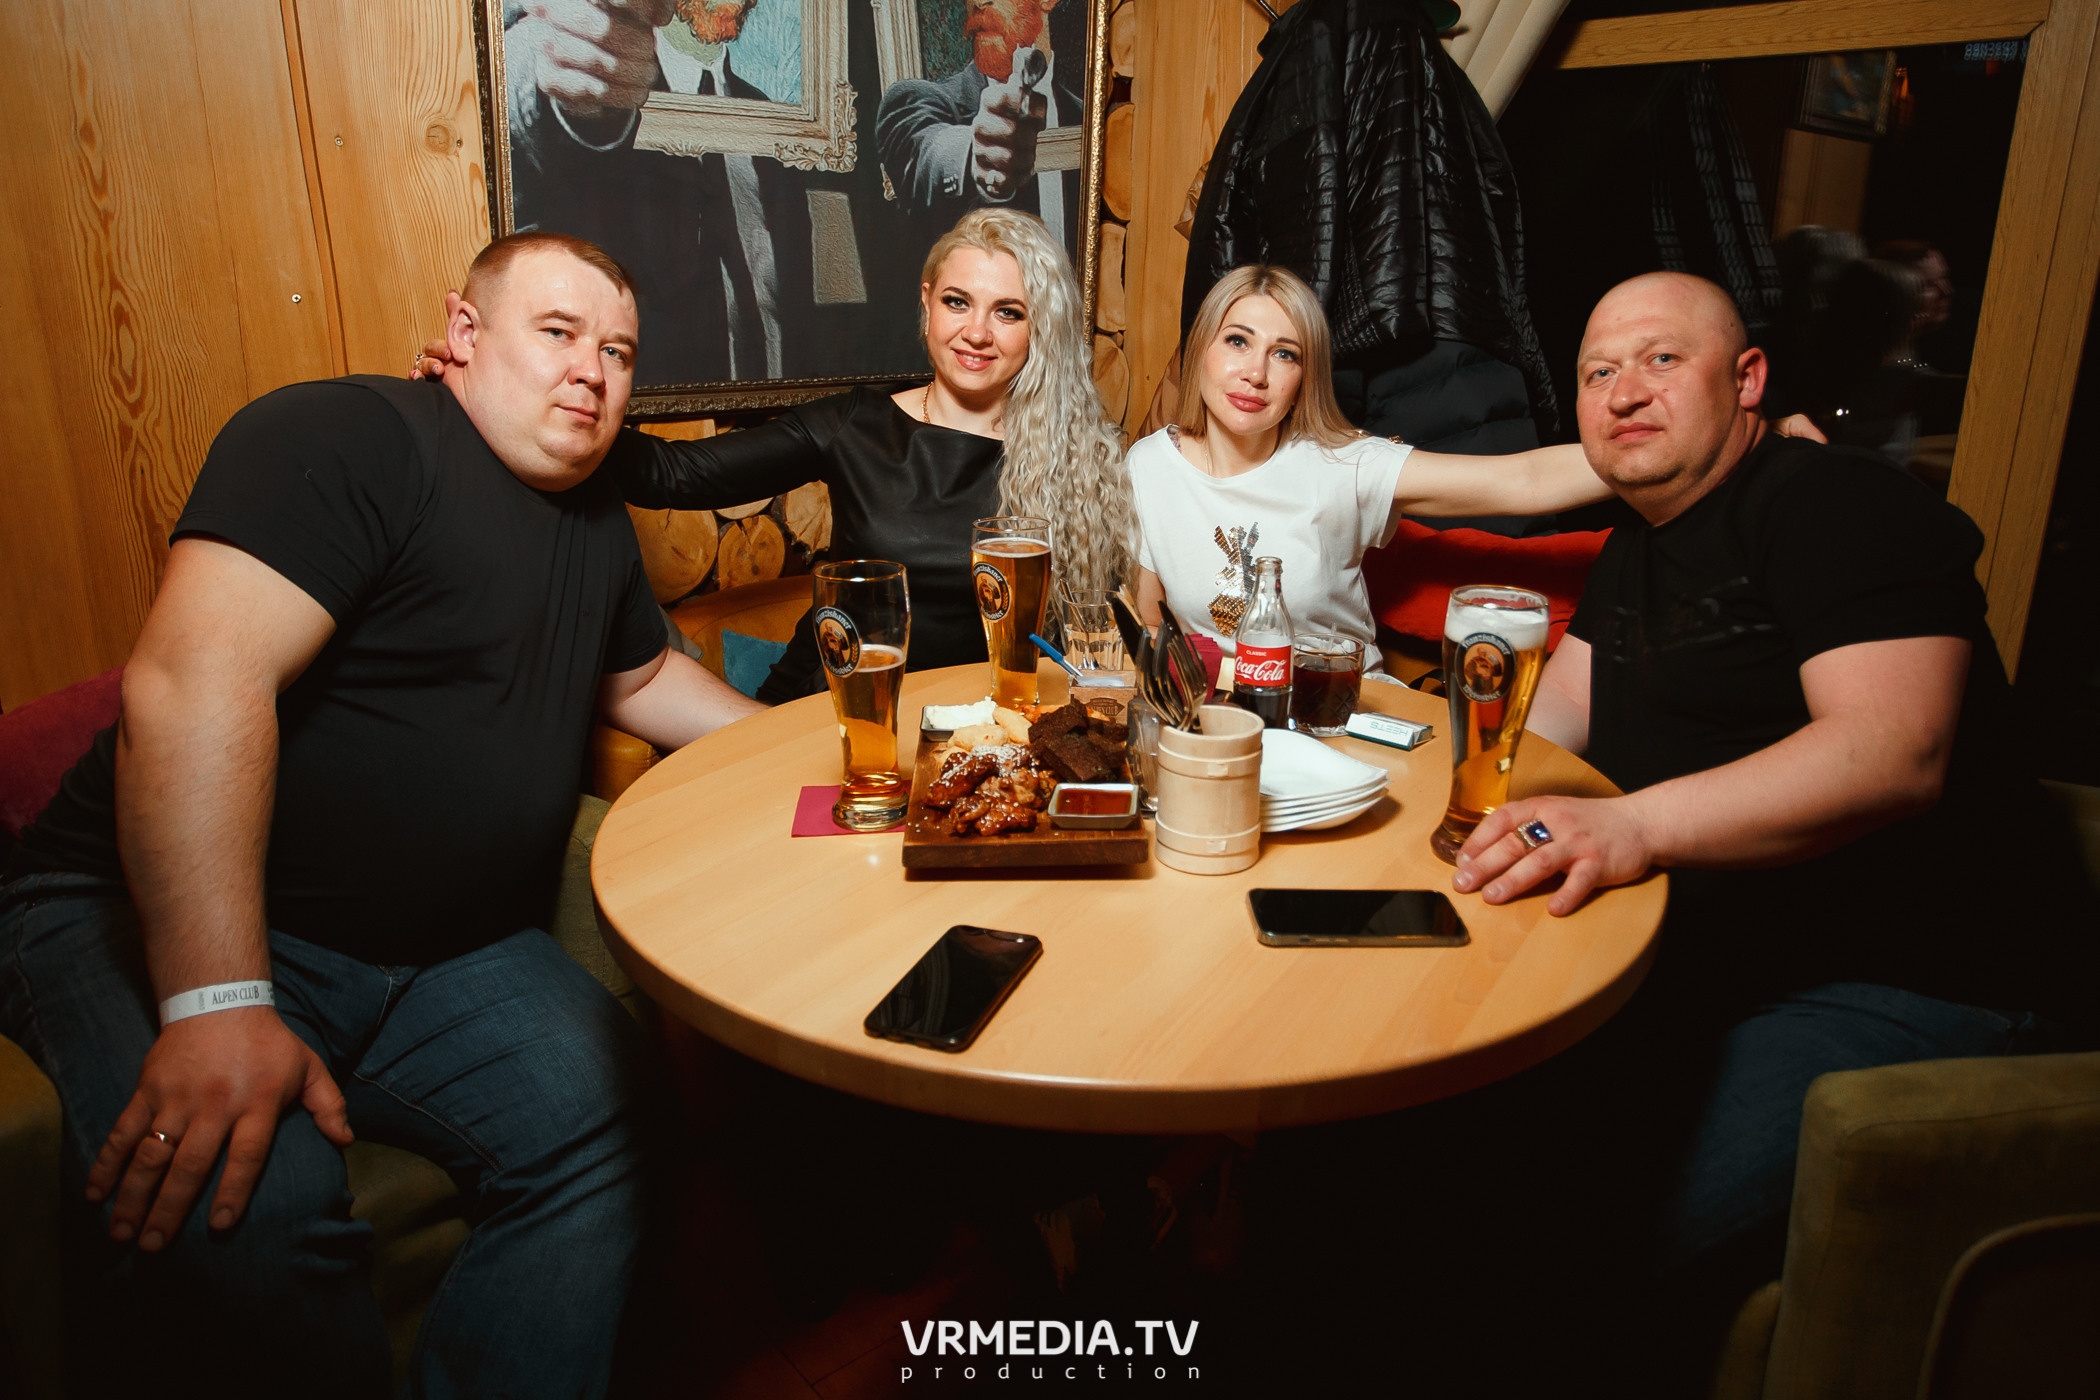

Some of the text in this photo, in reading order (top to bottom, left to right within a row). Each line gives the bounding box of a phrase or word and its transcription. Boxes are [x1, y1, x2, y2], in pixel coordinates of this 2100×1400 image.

[1246, 649, 1267, 657] CLASSIC
[1234, 656, 1287, 682] Coca-Cola
[1370, 721, 1409, 736] HEETS
[212, 989, 238, 1005] ALPEN
[239, 985, 260, 1000] CLUB
